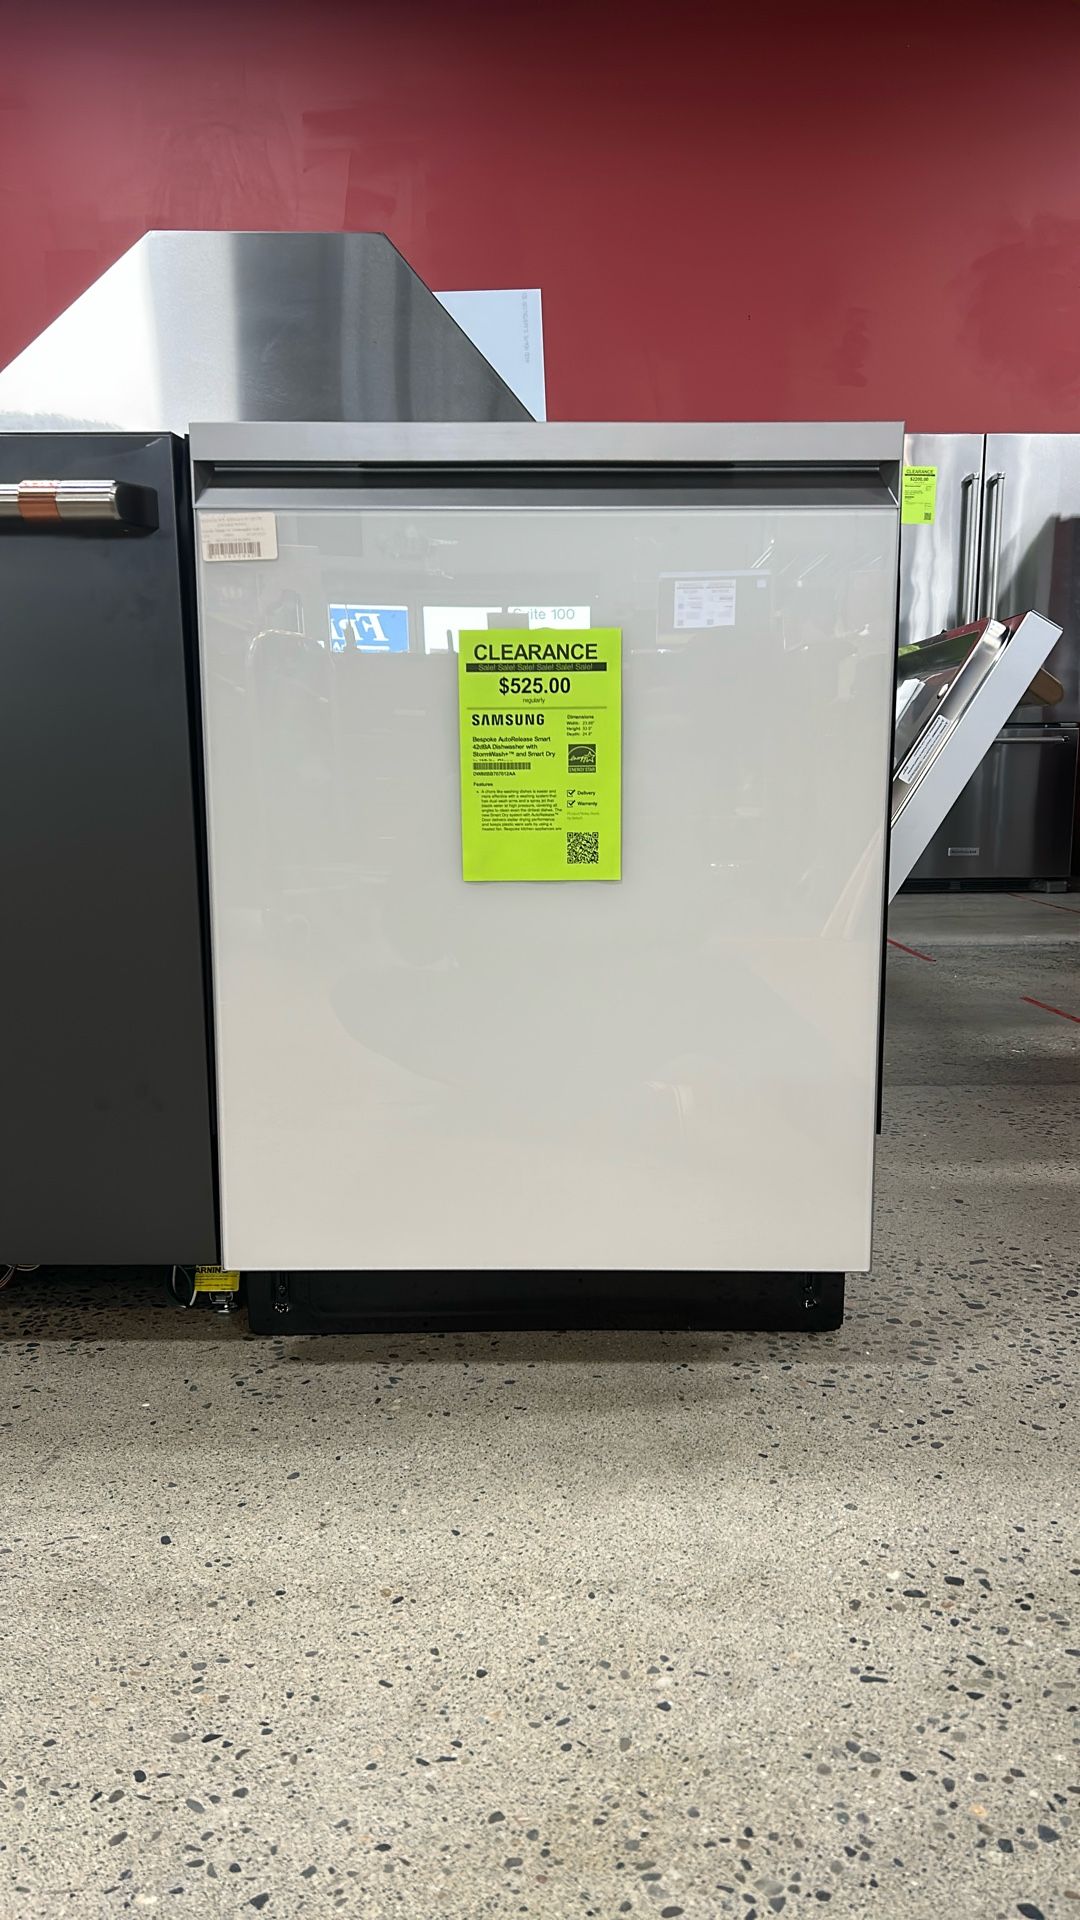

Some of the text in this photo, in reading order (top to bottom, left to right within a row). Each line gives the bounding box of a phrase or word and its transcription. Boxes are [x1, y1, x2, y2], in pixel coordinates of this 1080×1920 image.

[514, 608, 575, 620] ite 100
[474, 644, 598, 660] CLEARANCE
[499, 677, 570, 695] $525.00
[472, 714, 544, 726] SAMSUNG
